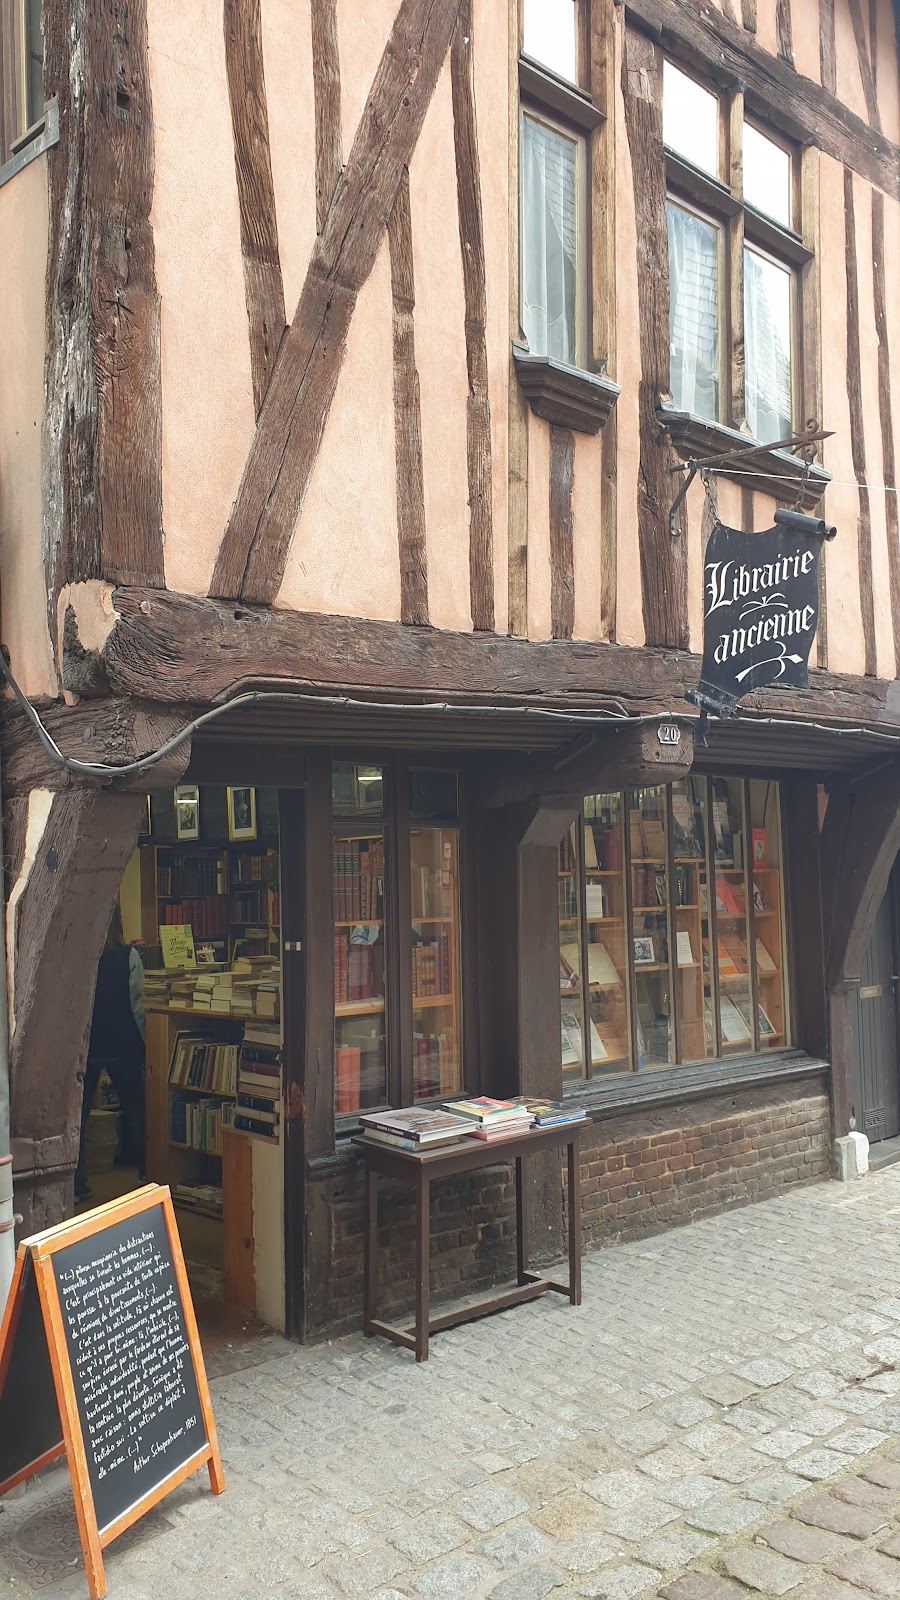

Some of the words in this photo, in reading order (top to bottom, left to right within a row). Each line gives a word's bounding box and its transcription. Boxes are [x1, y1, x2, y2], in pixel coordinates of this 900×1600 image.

[704, 549, 815, 620] Librairie
[713, 604, 815, 665] ancienne
[664, 726, 677, 741] 20
[62, 1277, 88, 1297] auxquelles
[89, 1274, 96, 1283] se
[96, 1262, 113, 1279] livrent
[113, 1260, 121, 1270] les
[121, 1252, 142, 1266] hommes,
[118, 1243, 127, 1254] des
[127, 1231, 155, 1250] distractions
[66, 1296, 81, 1311] C'est
[82, 1275, 116, 1307] principalement
[122, 1266, 134, 1279] vide
[133, 1257, 153, 1273] intérieur
[153, 1250, 162, 1266] qui
[68, 1315, 76, 1325] les
[77, 1306, 97, 1326] pousse
[98, 1299, 103, 1309] à
[103, 1294, 110, 1305] la
[111, 1280, 135, 1307] poursuite
[134, 1276, 142, 1287] de
[141, 1268, 154, 1281] toute
[154, 1261, 171, 1276] espèce
[72, 1328, 80, 1340] de
[101, 1312, 109, 1323] de
[76, 1349, 93, 1366] réduit
[92, 1346, 98, 1356] à
[97, 1343, 106, 1353] ses
[107, 1330, 125, 1351] propres
[125, 1316, 150, 1335] ressources,
[156, 1308, 163, 1316] se
[162, 1298, 178, 1312] montre
[79, 1335, 93, 1350] C'est
[93, 1330, 106, 1342] dans
[105, 1323, 113, 1334] la
[112, 1309, 137, 1330] solitude,
[135, 1304, 143, 1315] là
[142, 1300, 150, 1311] où
[150, 1292, 166, 1307] chacun
[165, 1284, 175, 1297] est
[79, 1370, 86, 1378] ce
[103, 1351, 114, 1366] pour
[81, 1375, 101, 1391] soupire
[102, 1358, 118, 1376] écrasé
[119, 1356, 128, 1371] par
[128, 1350, 134, 1359] le
[134, 1341, 151, 1359] fardeau
[152, 1328, 168, 1344] éternel
[168, 1324, 174, 1335] de
[174, 1323, 180, 1332] sa
[84, 1382, 109, 1405] misérable
[109, 1360, 142, 1387] individualité,
[140, 1348, 157, 1370] pendant
[157, 1346, 166, 1358] que
[165, 1335, 184, 1350] l'homme
[86, 1393, 113, 1421] hautement
[113, 1384, 128, 1401] doué,
[127, 1374, 142, 1395] peuple
[142, 1369, 149, 1379] et
[149, 1363, 161, 1375] anime
[162, 1355, 168, 1366] de
[174, 1342, 190, 1365] pensées
[88, 1424, 96, 1435] la
[95, 1410, 114, 1429] contrée
[115, 1404, 122, 1415] la
[122, 1398, 132, 1416] plus
[152, 1371, 171, 1388] Sénèque
[172, 1366, 177, 1374] a
[176, 1358, 184, 1370] dit
[91, 1434, 104, 1448] avec
[127, 1407, 141, 1422] omnis
[163, 1372, 182, 1394] laborat
[93, 1444, 115, 1465] fastidio
[129, 1425, 137, 1436] La
[157, 1404, 164, 1413] se
[180, 1383, 186, 1395] à
[133, 1455, 150, 1474] Arthur
[150, 1427, 186, 1458] Schopenhauer,
[185, 1414, 197, 1430] 1851
